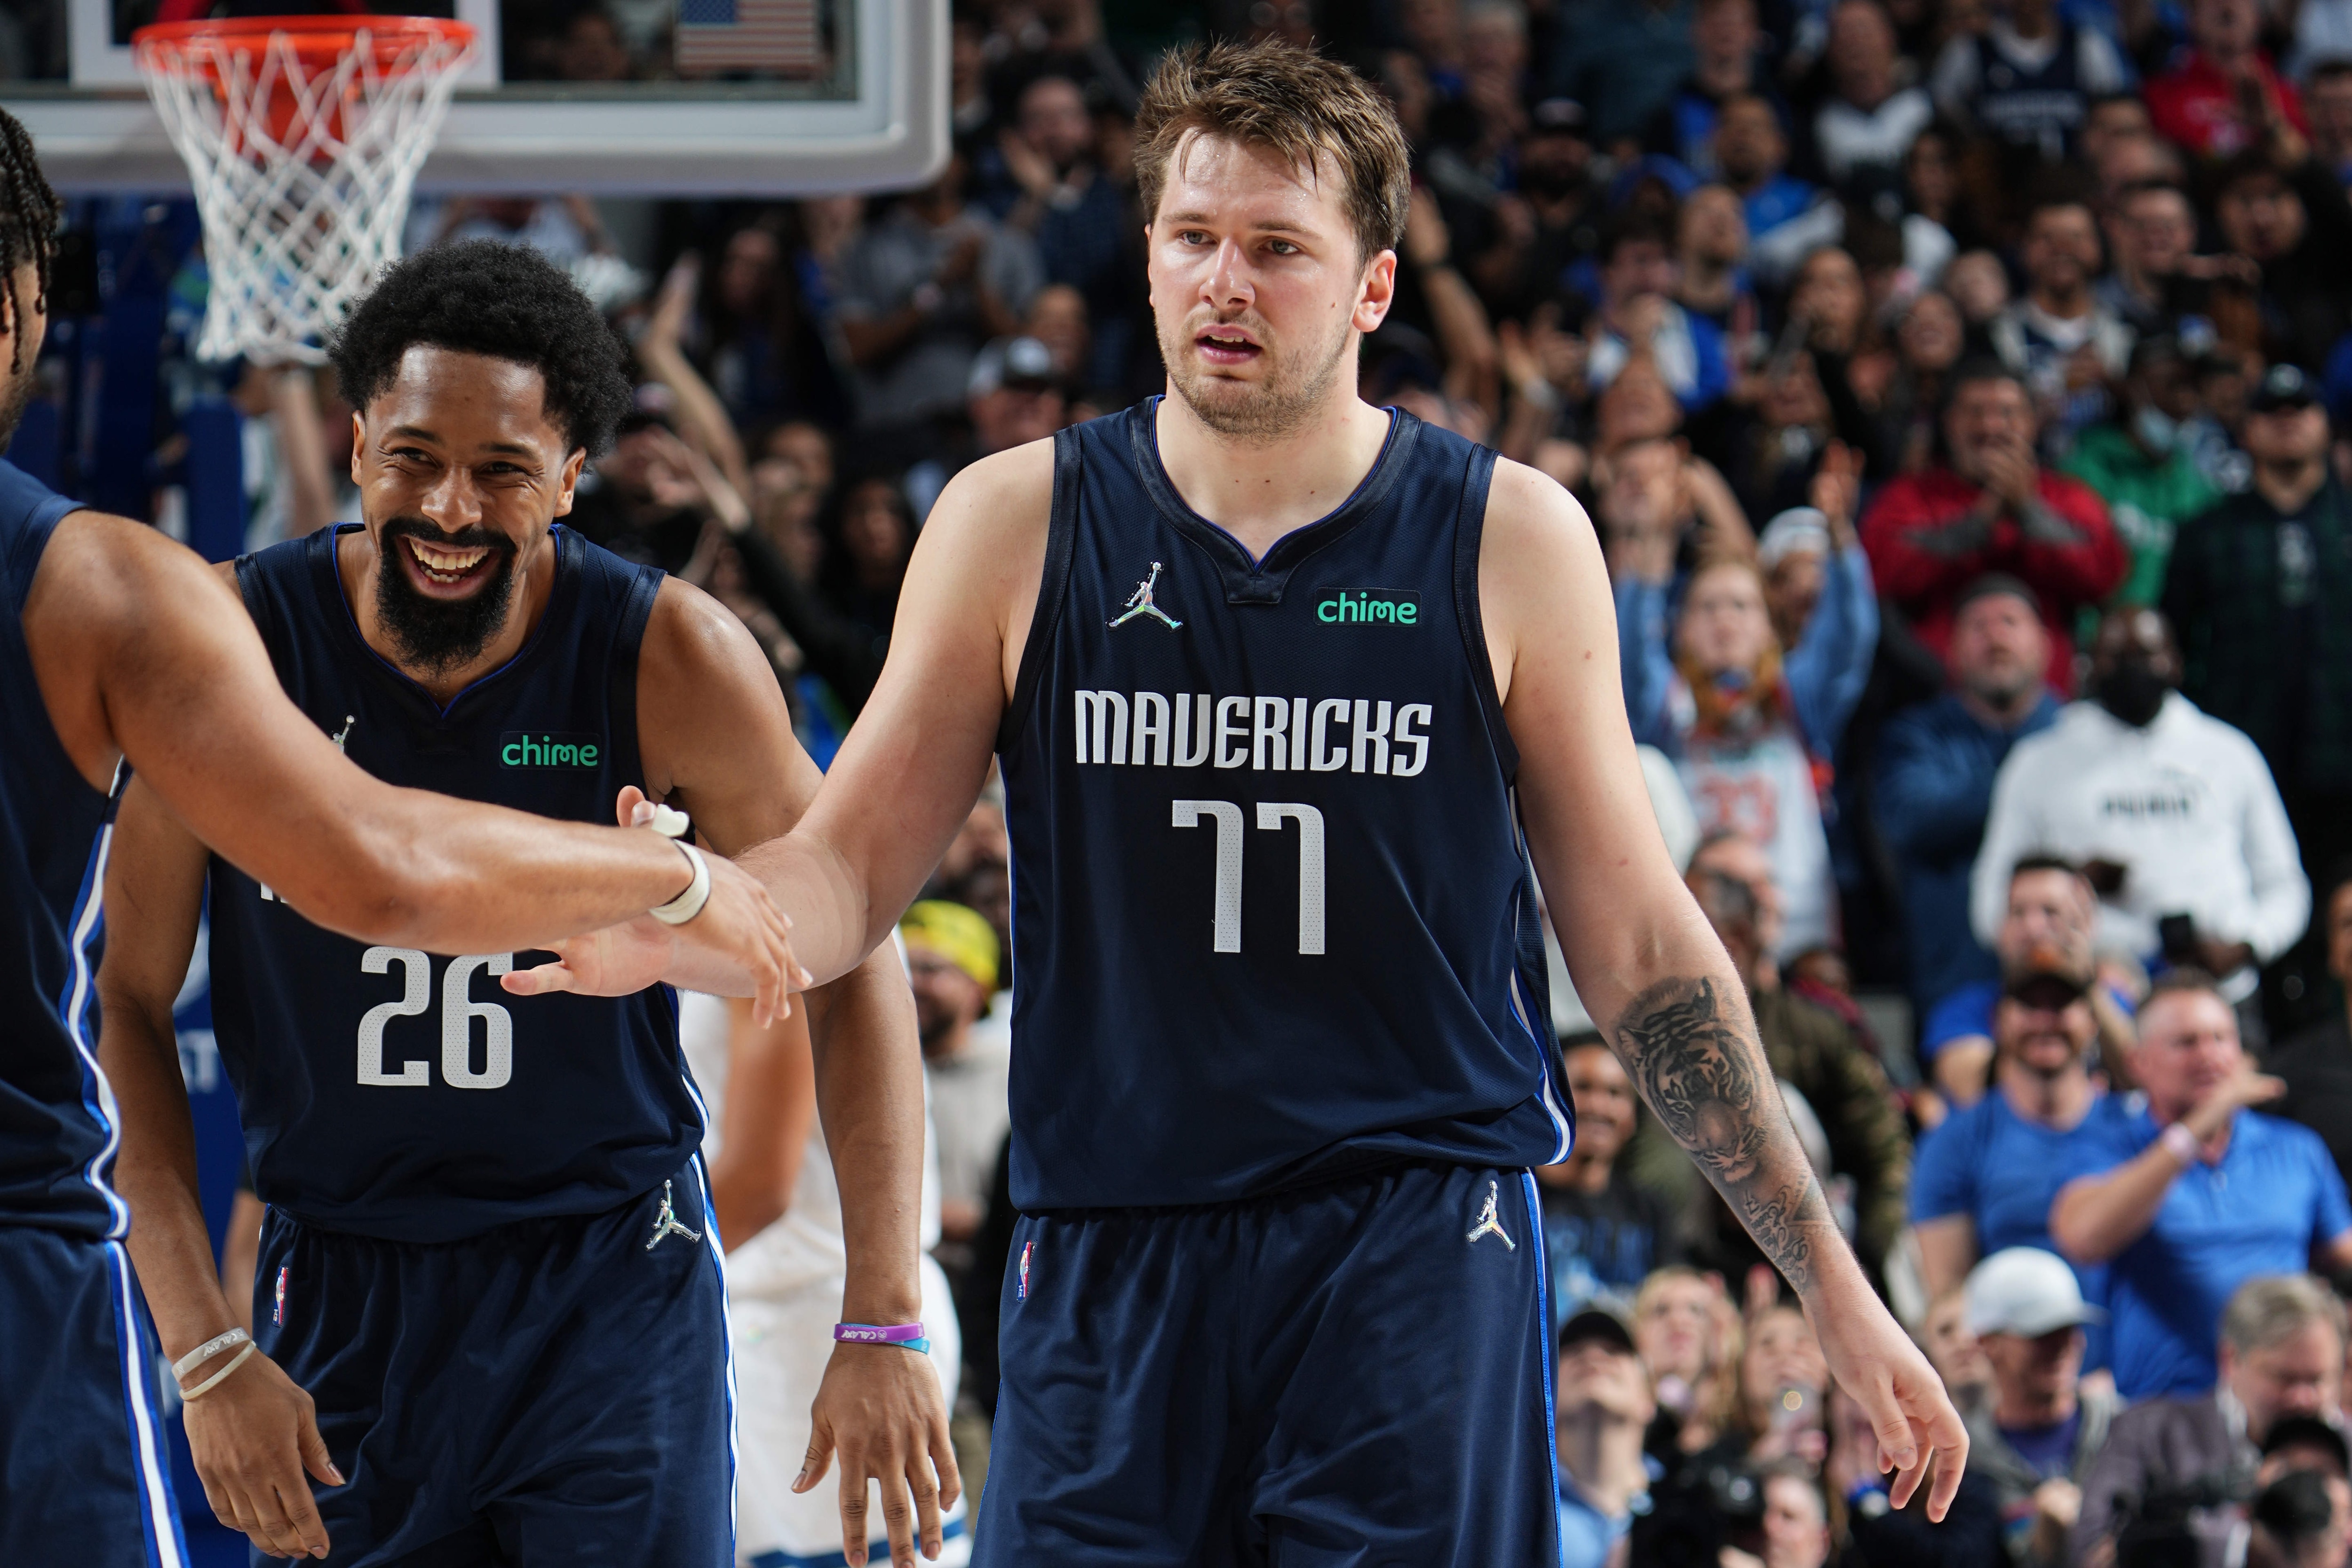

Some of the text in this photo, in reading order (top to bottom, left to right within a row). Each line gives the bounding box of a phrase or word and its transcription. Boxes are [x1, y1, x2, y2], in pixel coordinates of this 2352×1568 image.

[1318, 592, 1417, 625] chime
[502, 735, 597, 767] chime
[1075, 690, 1432, 777] MAVERICKS
[1172, 800, 1326, 955] 77
[357, 946, 513, 1089] 26
